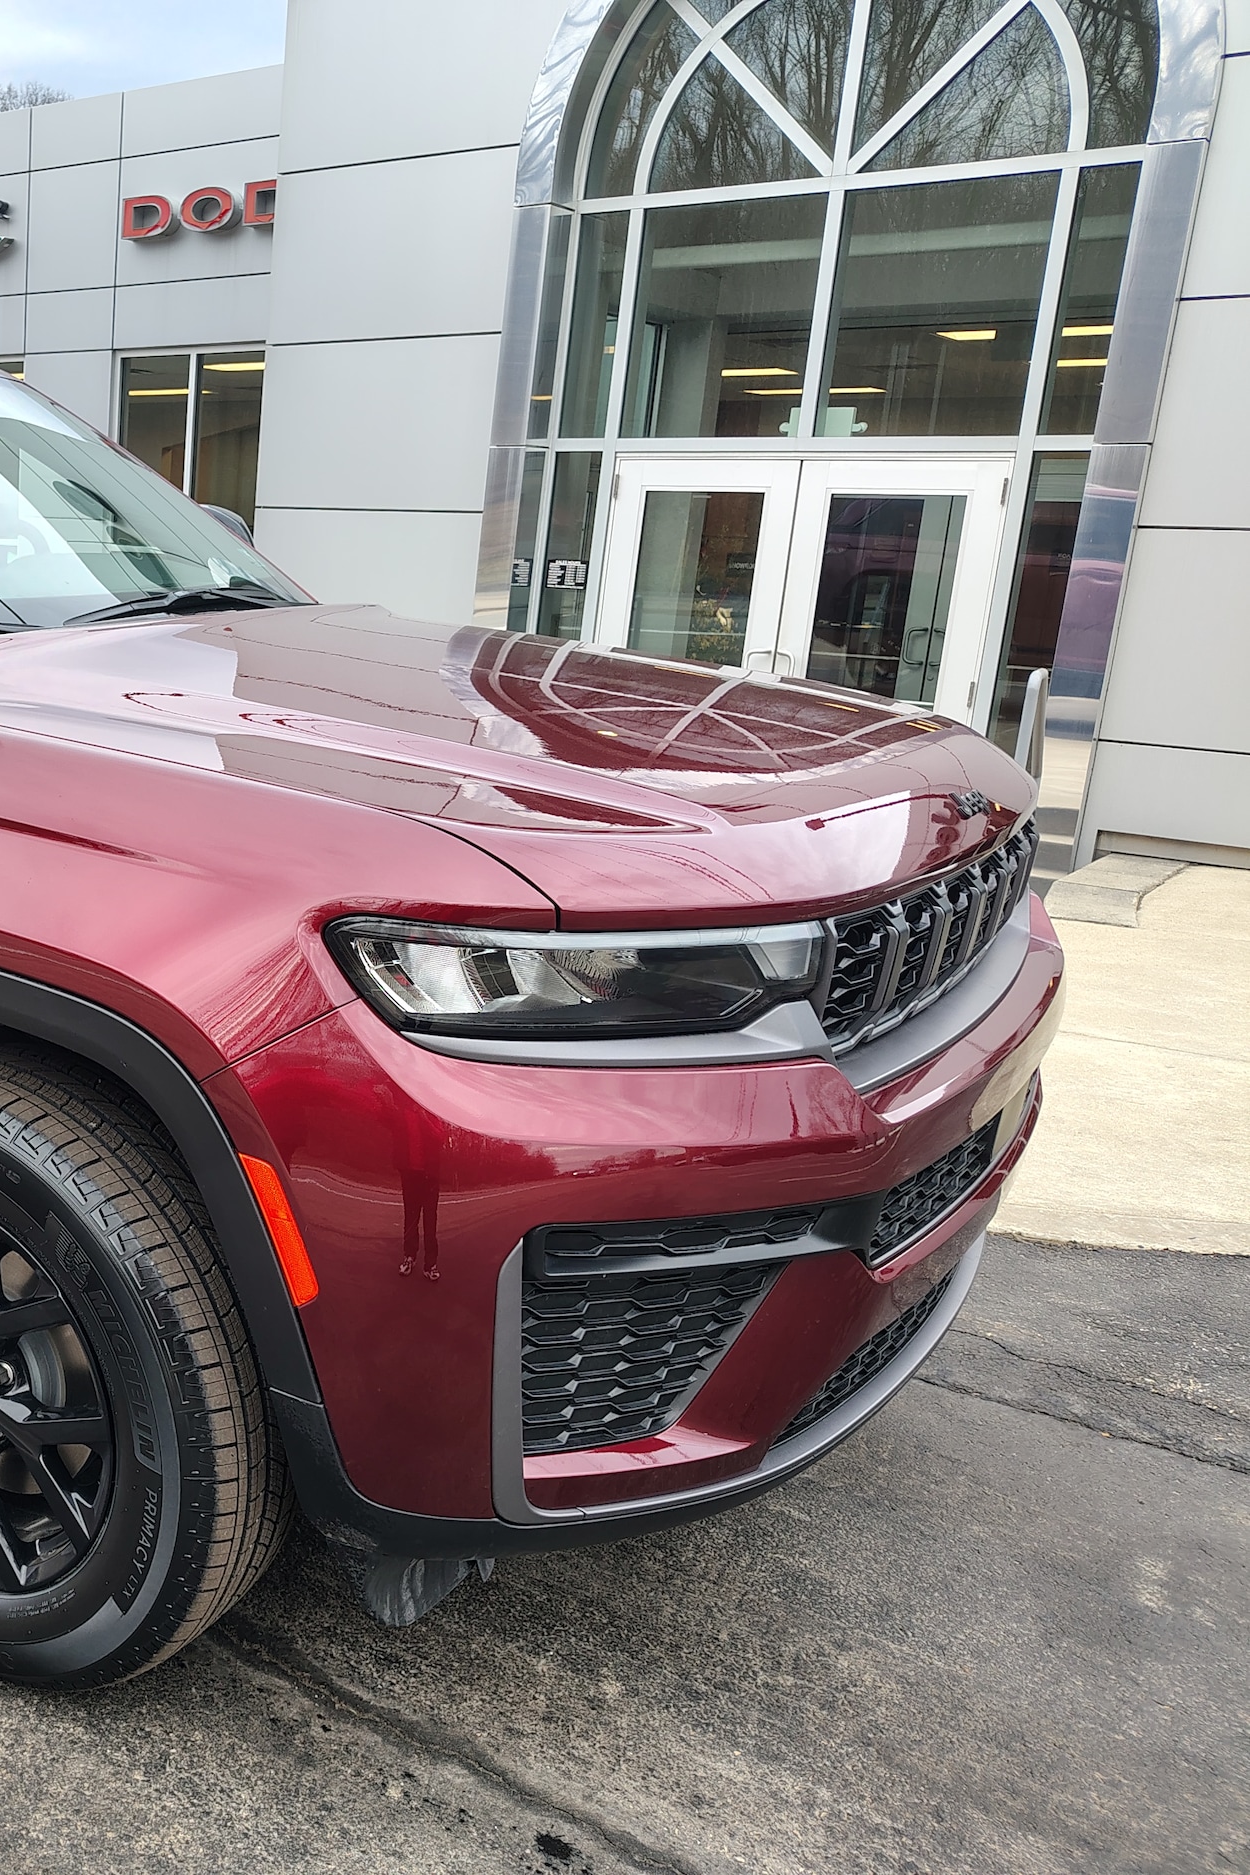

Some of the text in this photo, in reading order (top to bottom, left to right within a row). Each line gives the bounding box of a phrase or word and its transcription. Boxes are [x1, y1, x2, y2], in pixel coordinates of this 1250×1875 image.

[949, 788, 991, 820] Jeep
[88, 1289, 156, 1464] MICHELIN
[121, 1486, 158, 1599] PRIMACY LTX
